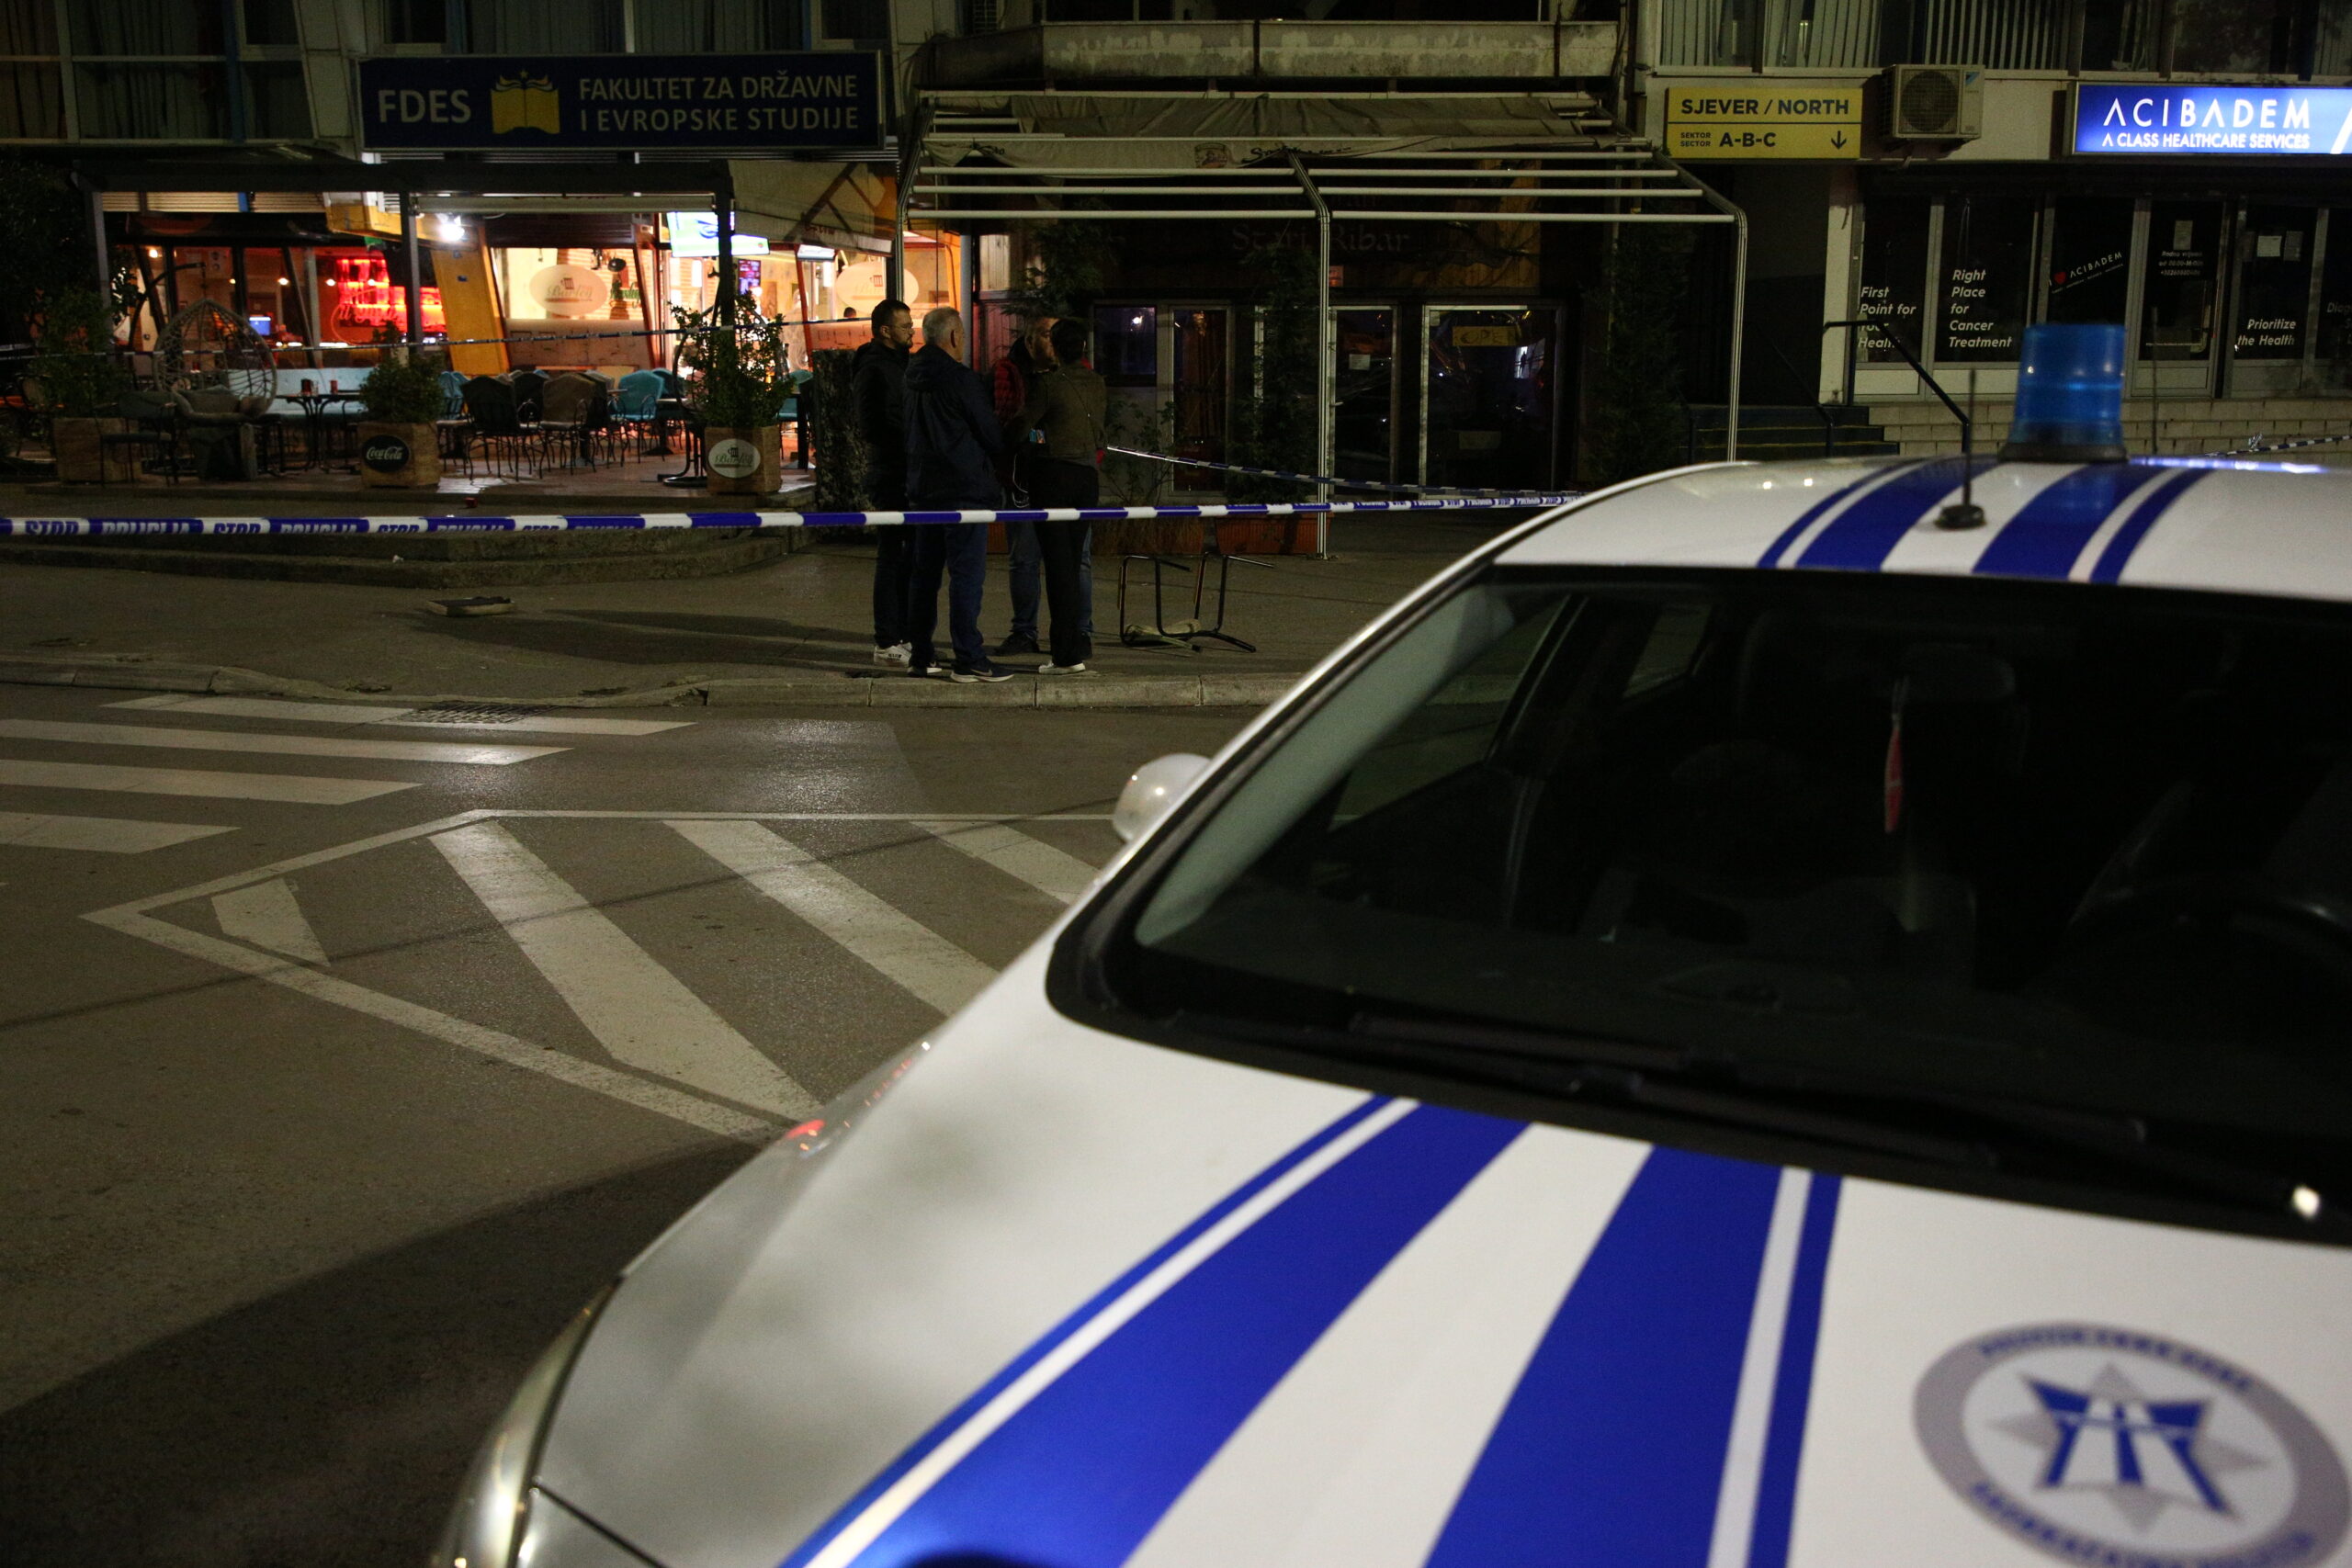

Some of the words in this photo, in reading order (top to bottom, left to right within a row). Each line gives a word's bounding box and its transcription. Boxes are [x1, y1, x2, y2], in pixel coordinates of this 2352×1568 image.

[579, 77, 696, 101] FAKULTET
[701, 76, 735, 100] ZA
[741, 69, 859, 99] DRŽAVNE
[378, 89, 472, 124] FDES
[1680, 98, 1759, 115] SJEVER
[1778, 98, 1849, 115] NORTH
[2102, 97, 2311, 130] ACIBADEM
[580, 109, 588, 132] I
[597, 107, 739, 132] EVROPSKE
[746, 107, 859, 130] STUDIJE
[1719, 131, 1777, 148] A-B-C
[2102, 132, 2114, 147] A
[2116, 132, 2159, 148] CLASS
[2162, 132, 2247, 149] HEALTHCARE
[2248, 133, 2311, 150] SERVICES
[2069, 251, 2122, 279] ACIBADEM
[1951, 268, 1987, 284] Right
[1860, 286, 1891, 299] First
[1951, 286, 1986, 299] Place
[1859, 302, 1894, 315] Point
[1896, 302, 1917, 315] for
[1950, 302, 1970, 315] for
[1949, 320, 1995, 332] Cancer
[2246, 318, 2297, 330] Prioritize
[1948, 336, 2013, 348] Treatment
[2237, 334, 2256, 346] the
[2258, 334, 2296, 346] Health
